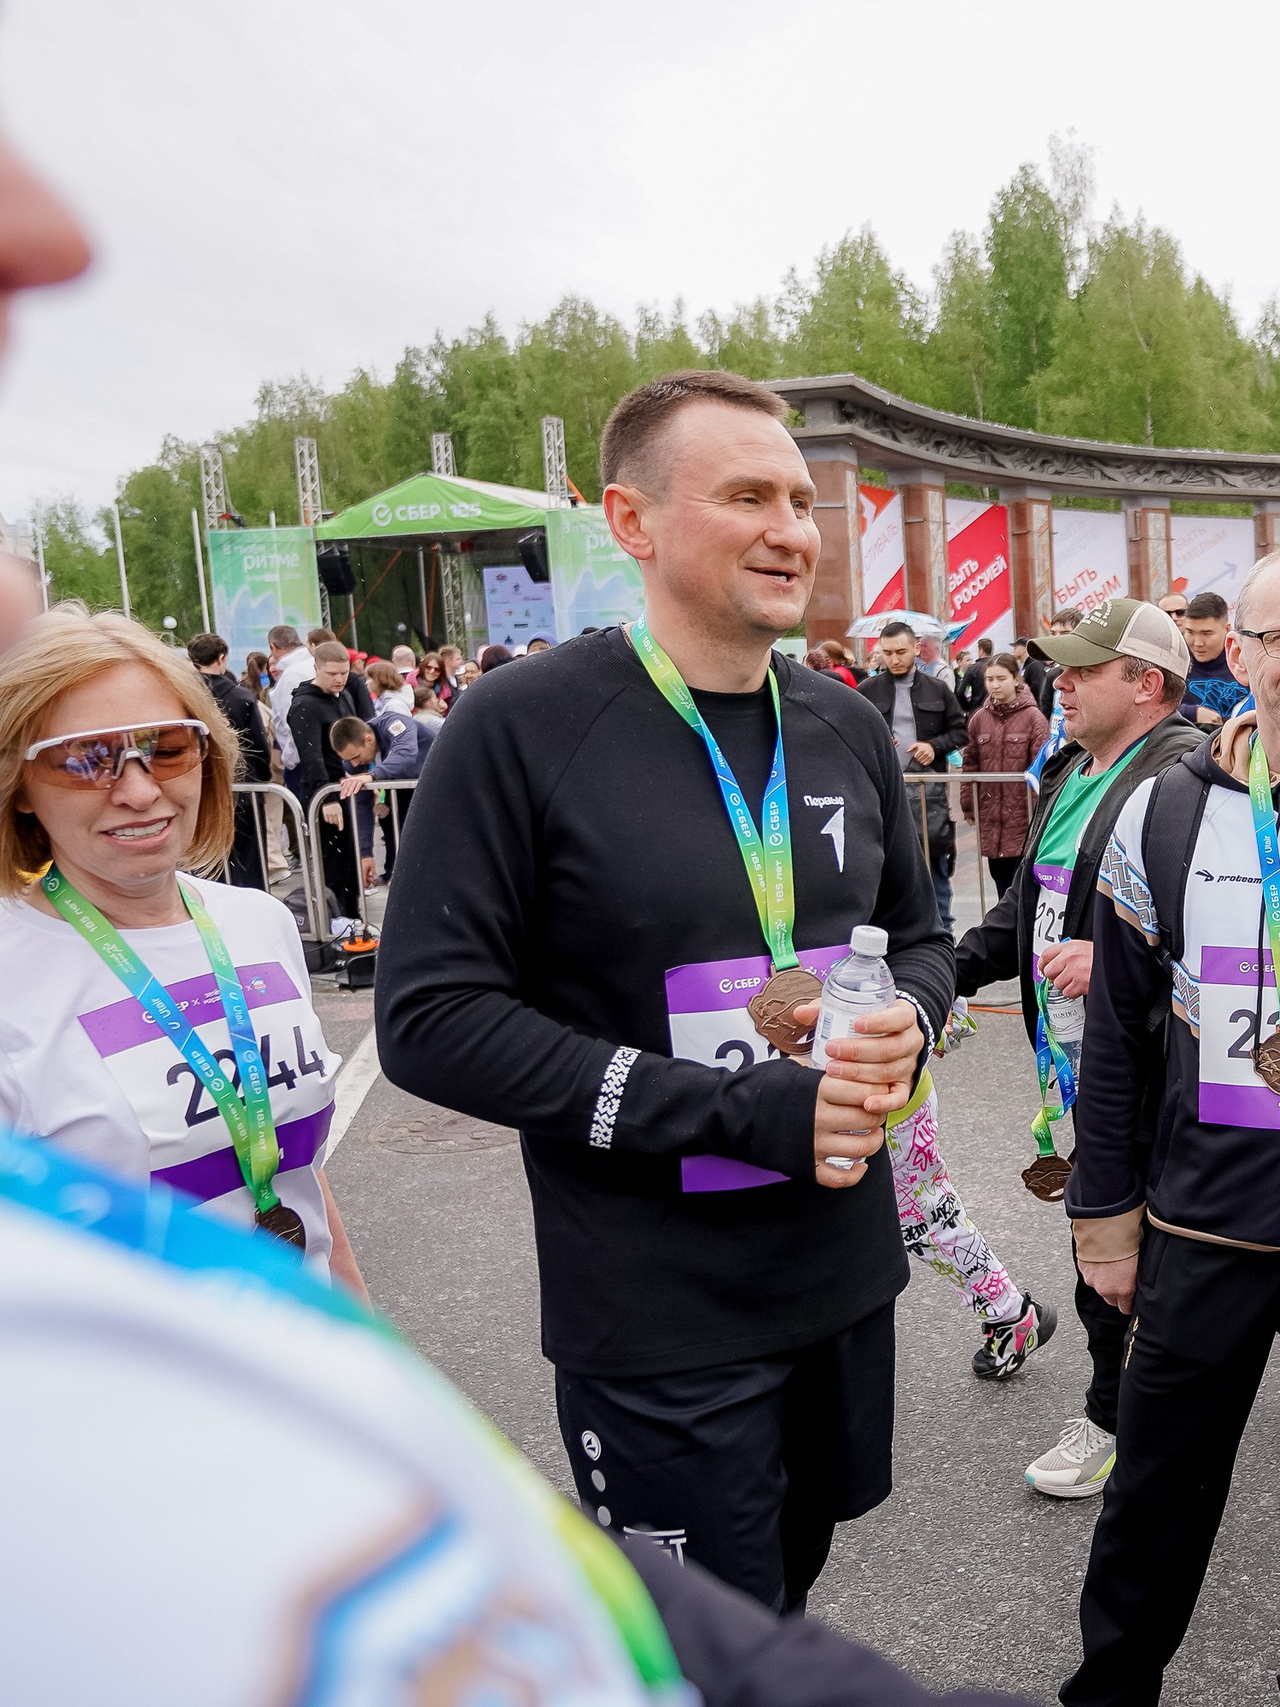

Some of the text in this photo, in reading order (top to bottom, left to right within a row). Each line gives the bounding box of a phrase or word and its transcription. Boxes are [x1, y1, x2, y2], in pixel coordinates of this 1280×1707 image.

[395, 503, 441, 521] СБЕР
[243, 552, 299, 573] ритме
[949, 560, 979, 592] БЫТЬ
[953, 555, 1008, 610] РОССИЕЙ
[1055, 569, 1098, 605] БЫТЬ
[1074, 575, 1121, 614] РВЫМ
[803, 795, 844, 809] Первые
[736, 808, 752, 838] СБЕР
[769, 801, 781, 830] СБЕР
[1264, 835, 1273, 853] Utair
[751, 851, 762, 871] 185
[1217, 874, 1262, 885] proteam
[775, 883, 784, 903] 185
[1269, 884, 1280, 909] СБЕР
[1251, 964, 1276, 973] СЕР
[734, 976, 761, 989] СБЕР
[191, 1050, 215, 1077] СБЕР
[248, 1065, 263, 1095] СБЕР
